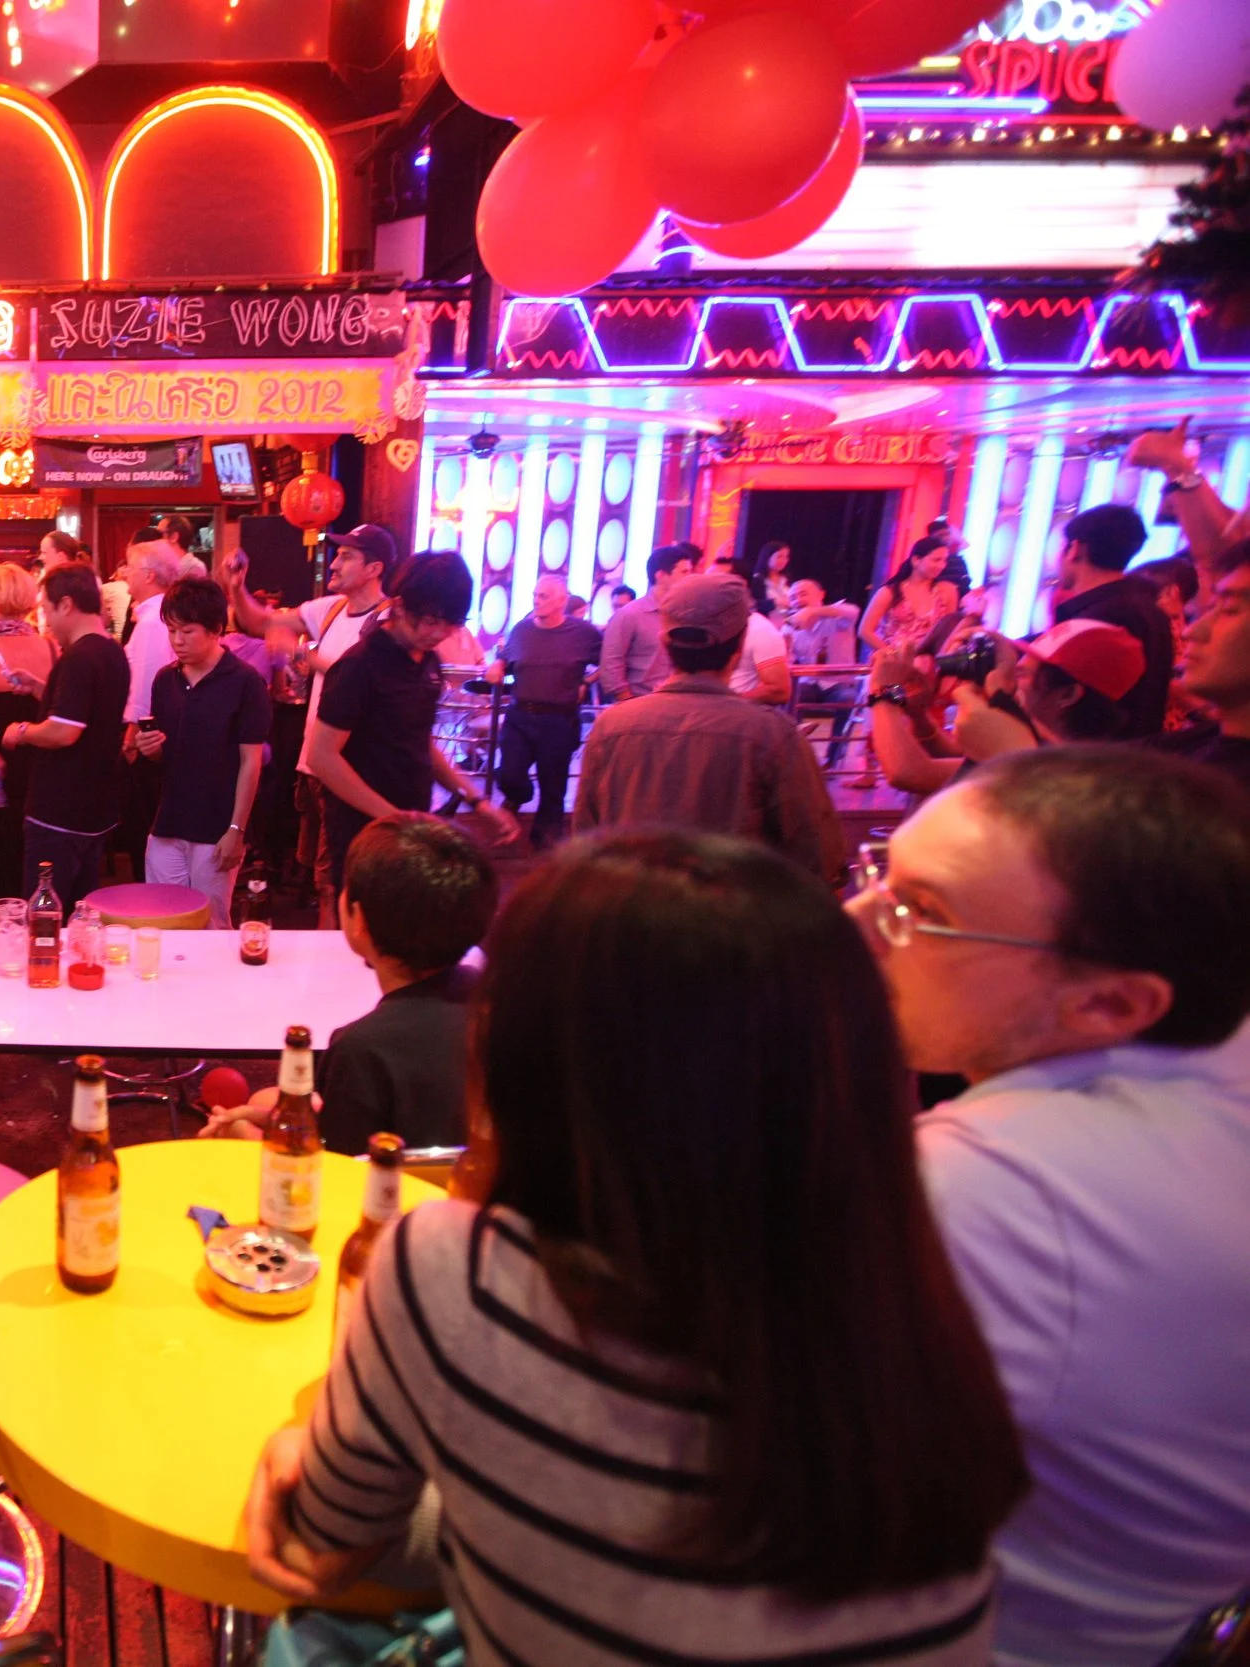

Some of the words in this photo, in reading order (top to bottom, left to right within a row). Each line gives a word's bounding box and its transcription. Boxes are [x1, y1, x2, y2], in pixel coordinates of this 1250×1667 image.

[964, 40, 1122, 102] SPIC
[50, 298, 206, 348] SUZIE
[230, 294, 370, 346] WONG
[257, 378, 347, 416] 2012
[87, 445, 147, 465] Carlsberg
[45, 471, 75, 482] HERE
[76, 471, 104, 482] NOW
[113, 471, 131, 481] ON
